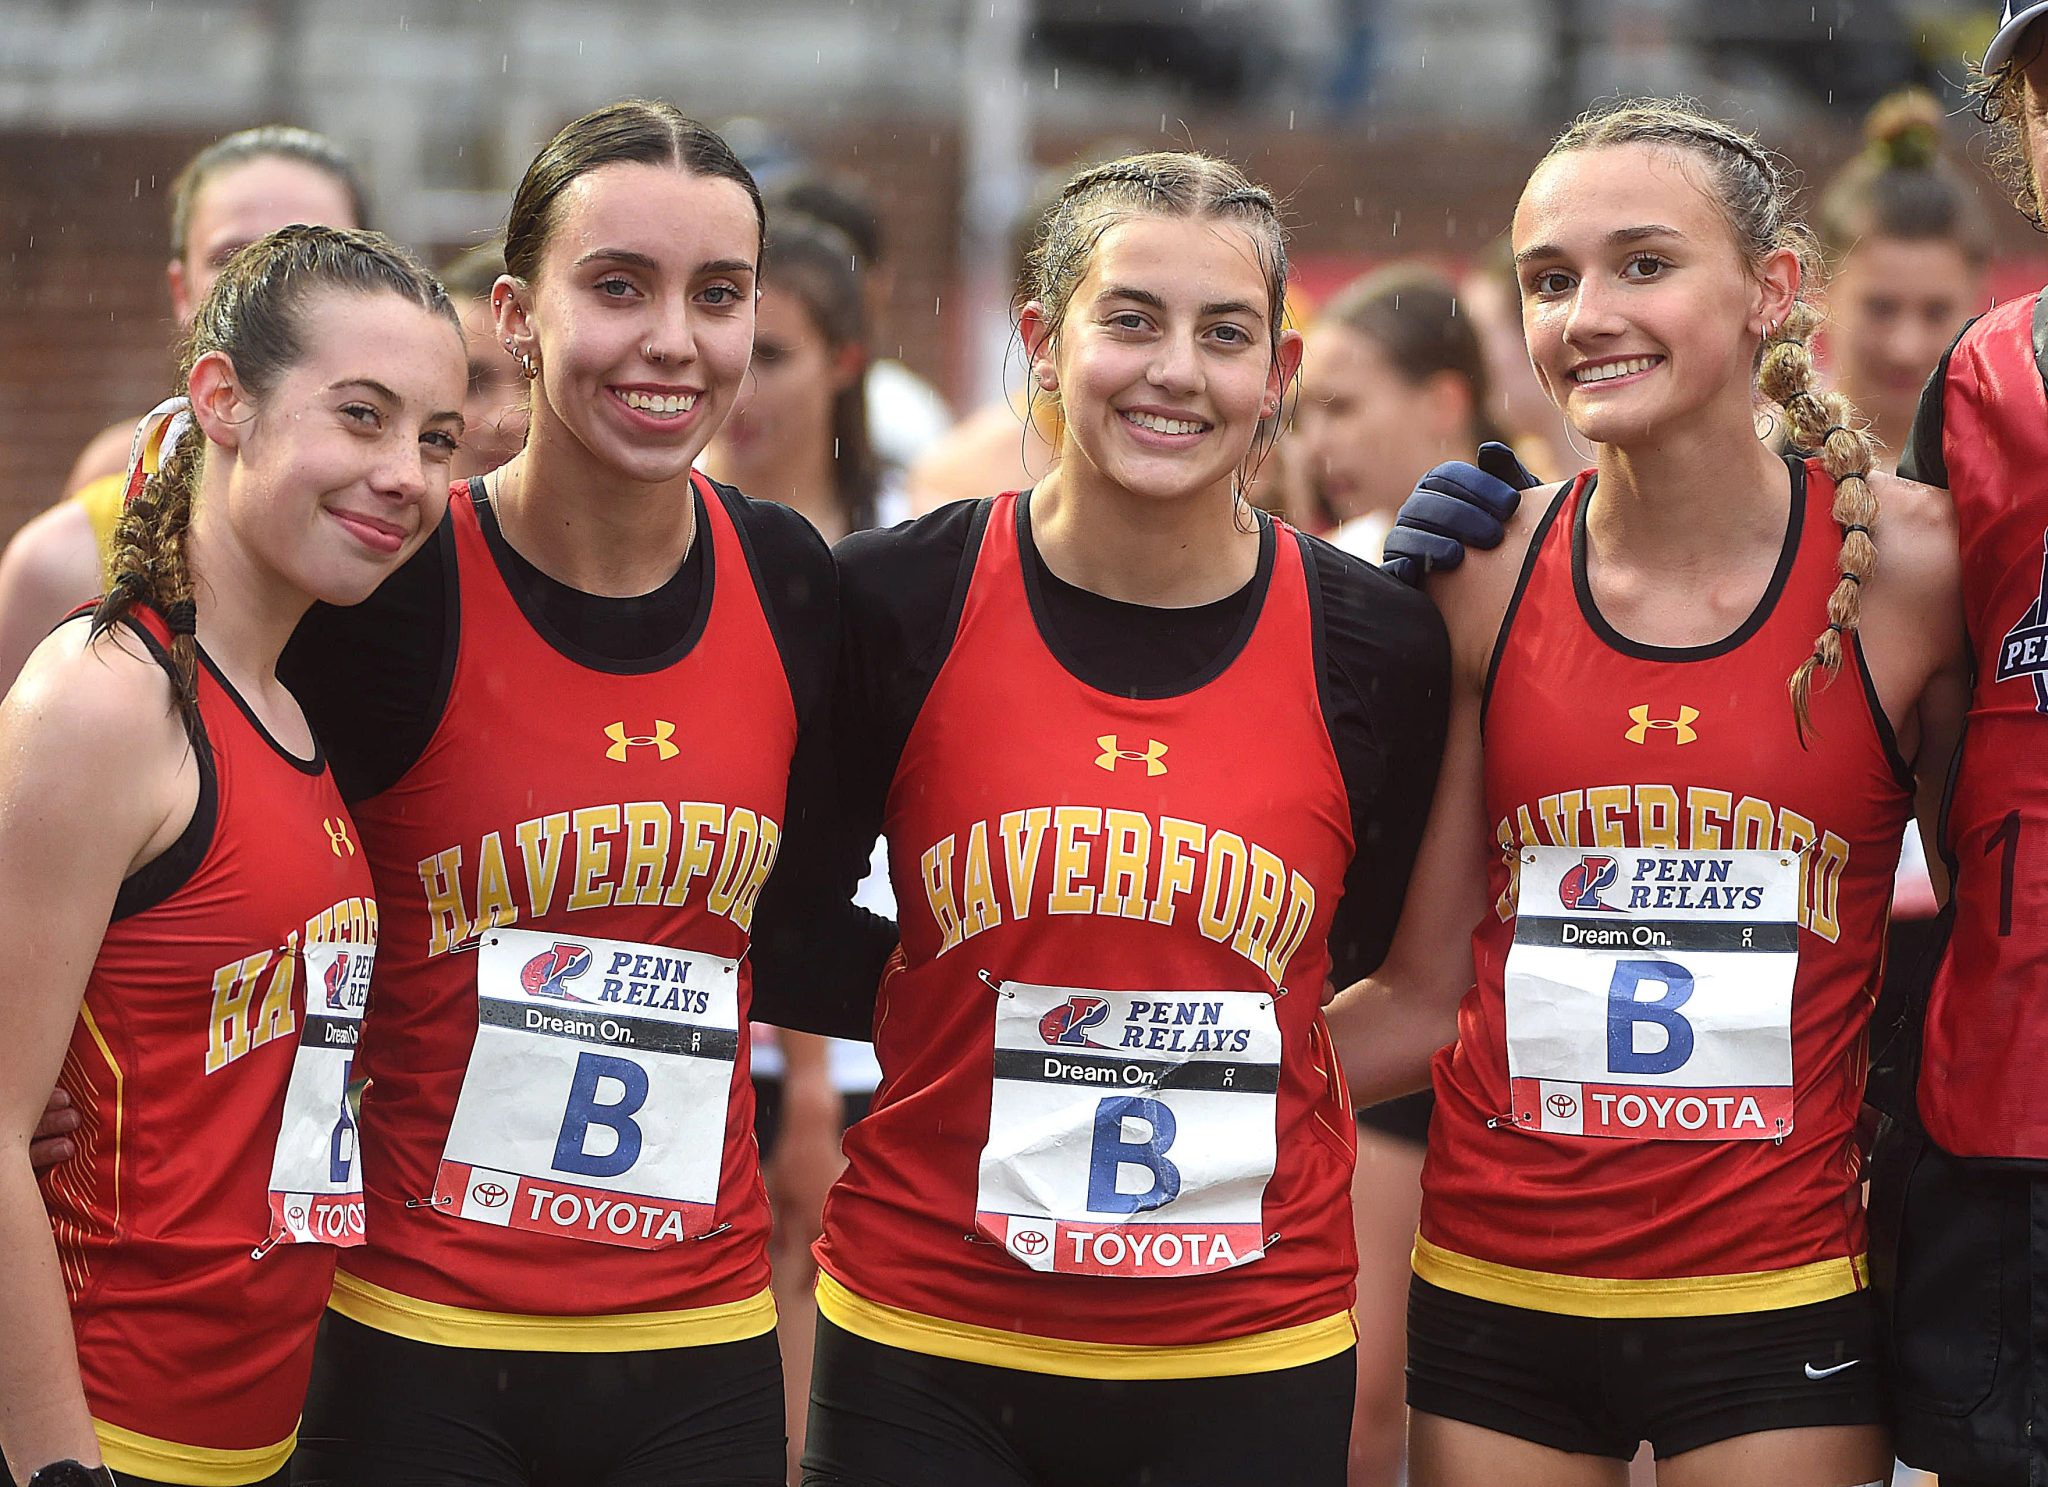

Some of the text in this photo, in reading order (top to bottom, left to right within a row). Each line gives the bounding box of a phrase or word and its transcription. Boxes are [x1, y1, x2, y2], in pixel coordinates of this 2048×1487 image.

[418, 801, 782, 958] HAVERFOR
[1631, 858, 1733, 882] PENN
[1984, 809, 2021, 937] 1
[920, 806, 1316, 988] HAVERFORD
[1627, 886, 1764, 910] RELAYS
[1561, 923, 1672, 947] Dream On.
[606, 951, 692, 984] PENN
[597, 978, 710, 1014] RELAYS
[1125, 1000, 1224, 1026] PENN
[525, 1008, 636, 1044] Dream On.
[1606, 959, 1695, 1075] B
[1119, 1025, 1251, 1053] RELAYS
[1043, 1058, 1159, 1085] Dream On.
[550, 1051, 651, 1178] B
[1591, 1093, 1766, 1130] TOYOTA
[1086, 1095, 1182, 1214] B
[527, 1187, 684, 1243] TOYOTA
[1066, 1230, 1238, 1267] TOYOTA
